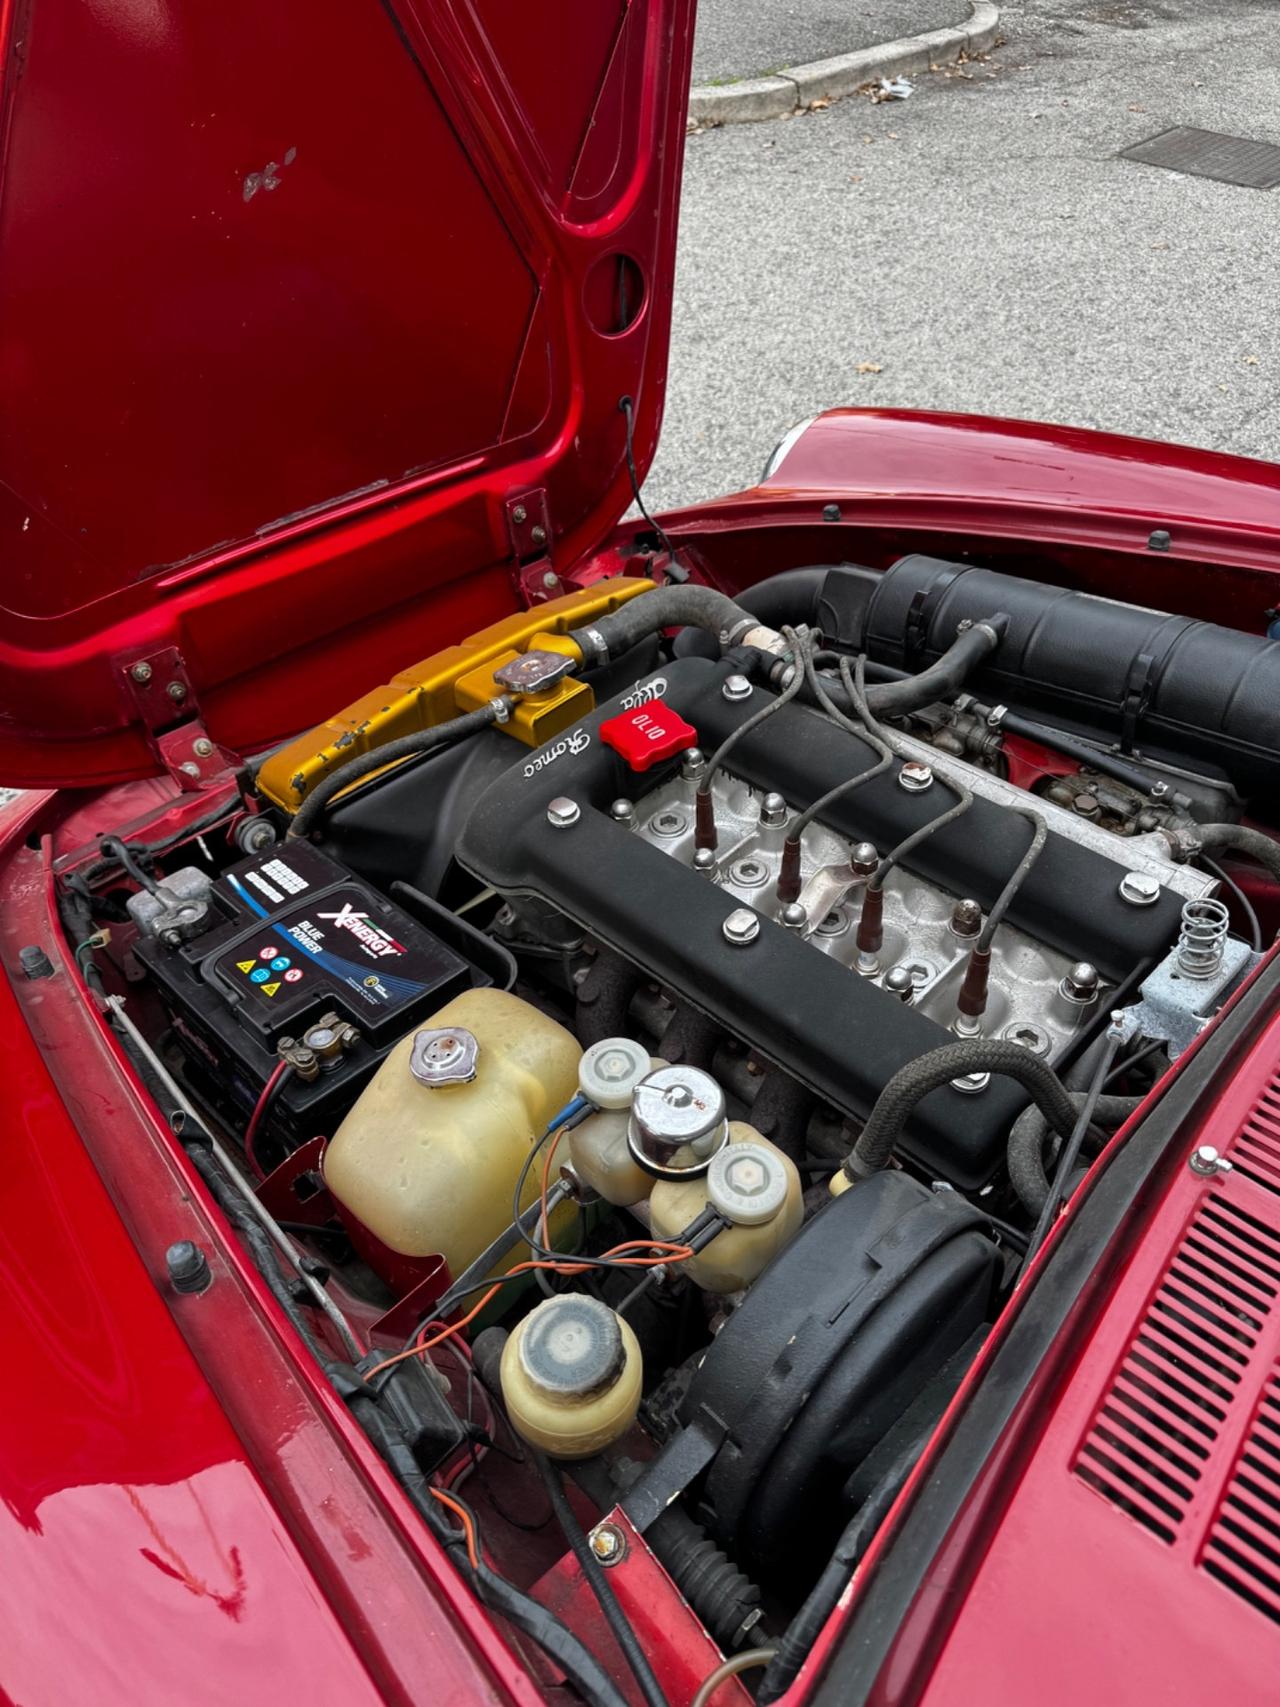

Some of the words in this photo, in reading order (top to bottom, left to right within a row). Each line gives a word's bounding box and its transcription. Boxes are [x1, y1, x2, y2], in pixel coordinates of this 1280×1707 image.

[631, 714, 666, 740] OLIO
[523, 728, 591, 778] Romeo
[287, 926, 324, 954] POWER
[297, 920, 326, 941] BLUE
[316, 902, 399, 957] XENERGY
